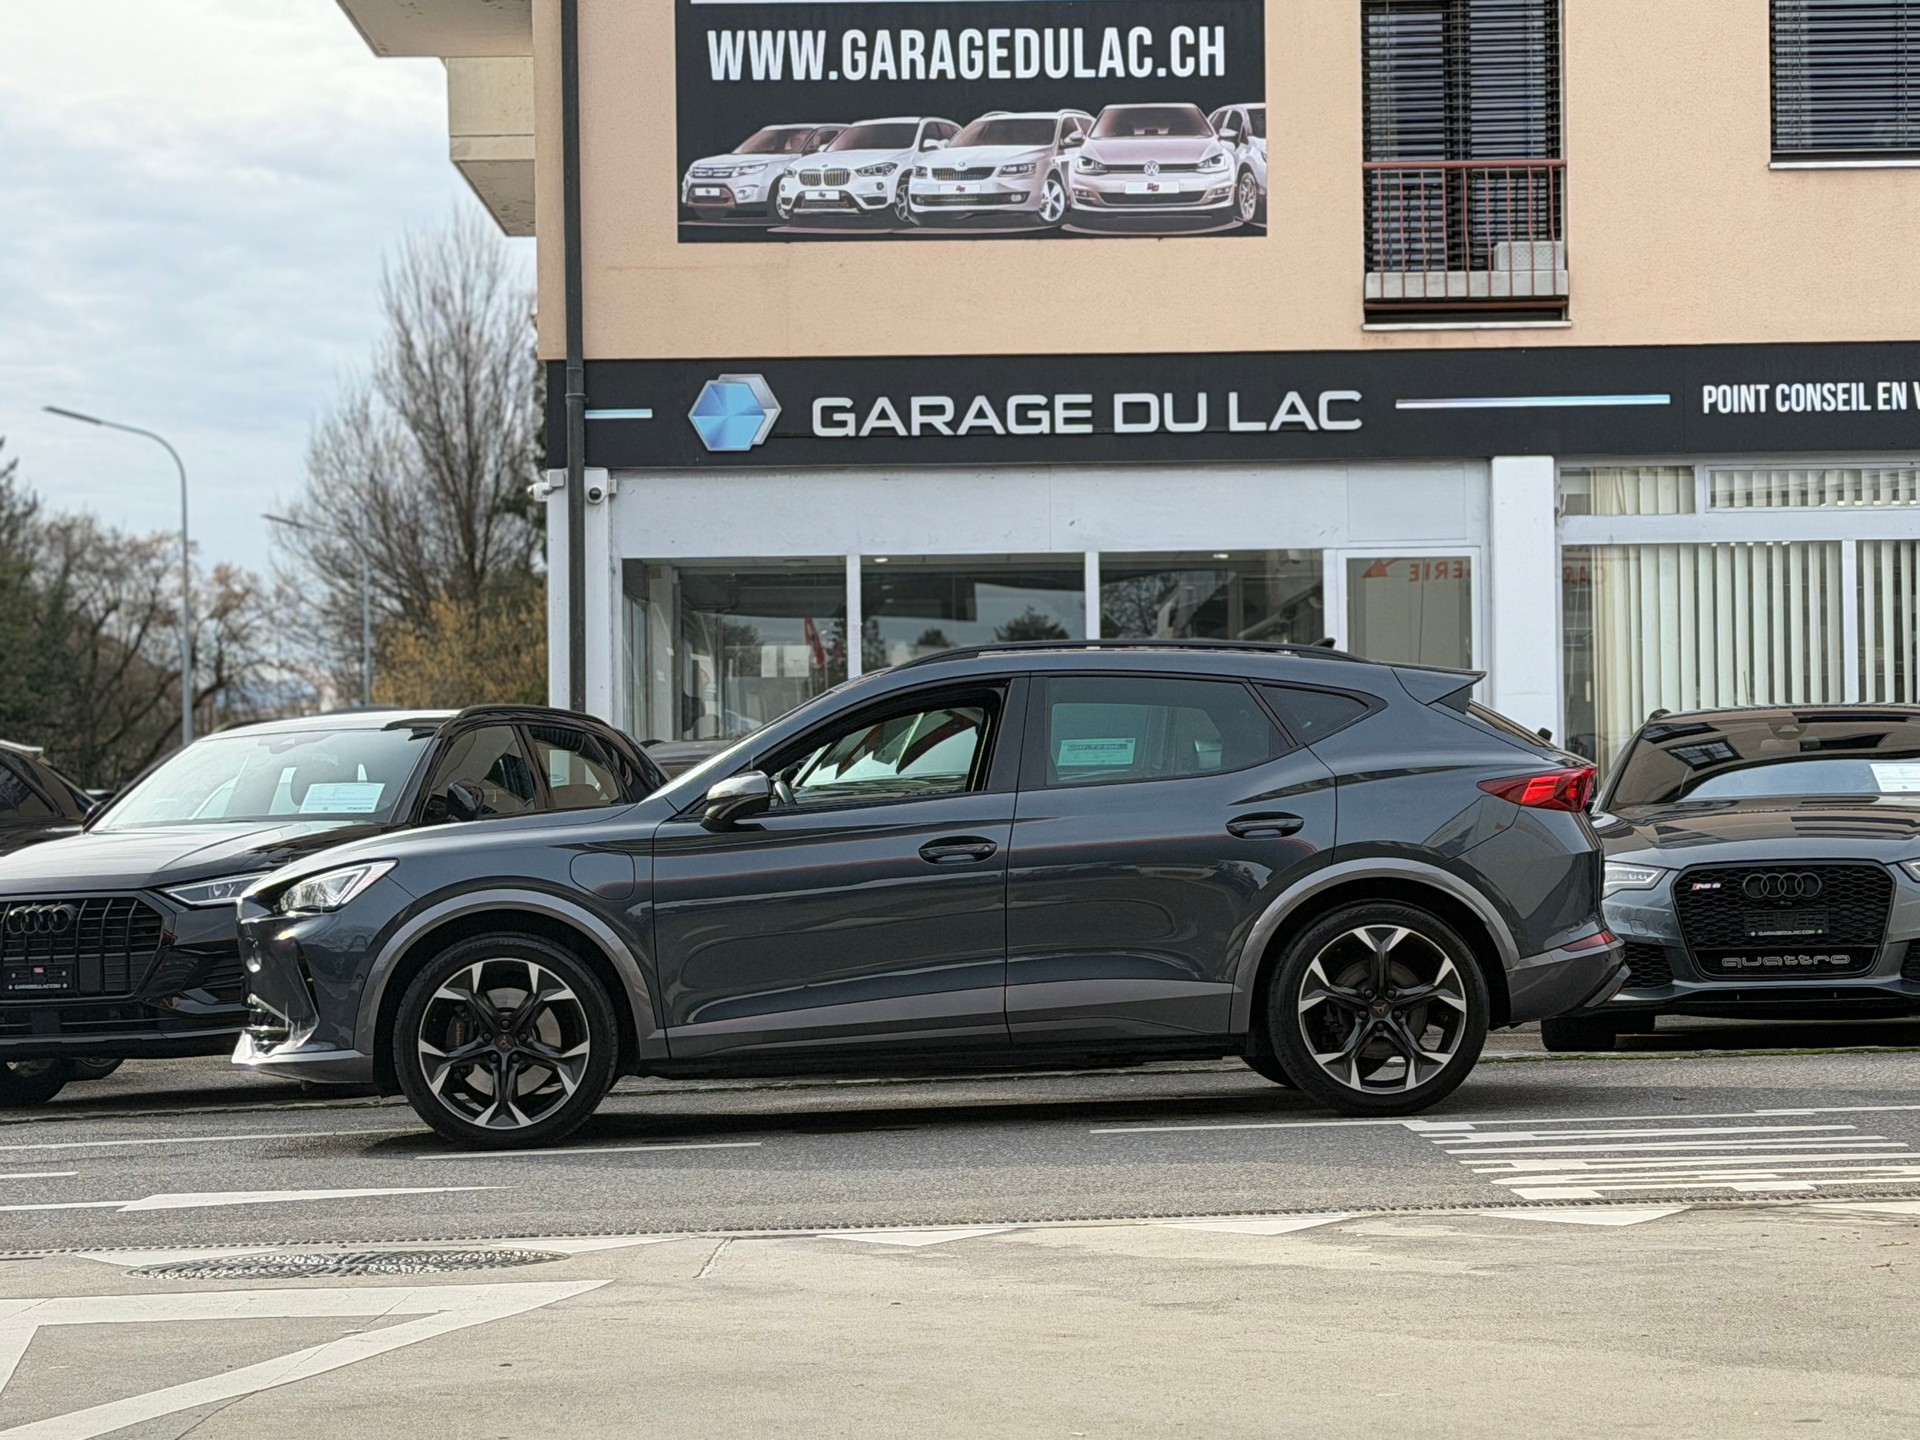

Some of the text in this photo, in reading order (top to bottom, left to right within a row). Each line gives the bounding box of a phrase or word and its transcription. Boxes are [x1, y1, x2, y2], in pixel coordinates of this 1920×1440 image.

[707, 26, 1226, 81] WWW.GARAGEDULAC.CH
[812, 390, 1362, 437] GARAGE DU LAC
[1703, 384, 1770, 414] POINT
[1775, 382, 1872, 413] CONSEIL
[1877, 381, 1907, 411] EN
[1722, 954, 1851, 968] quattro
